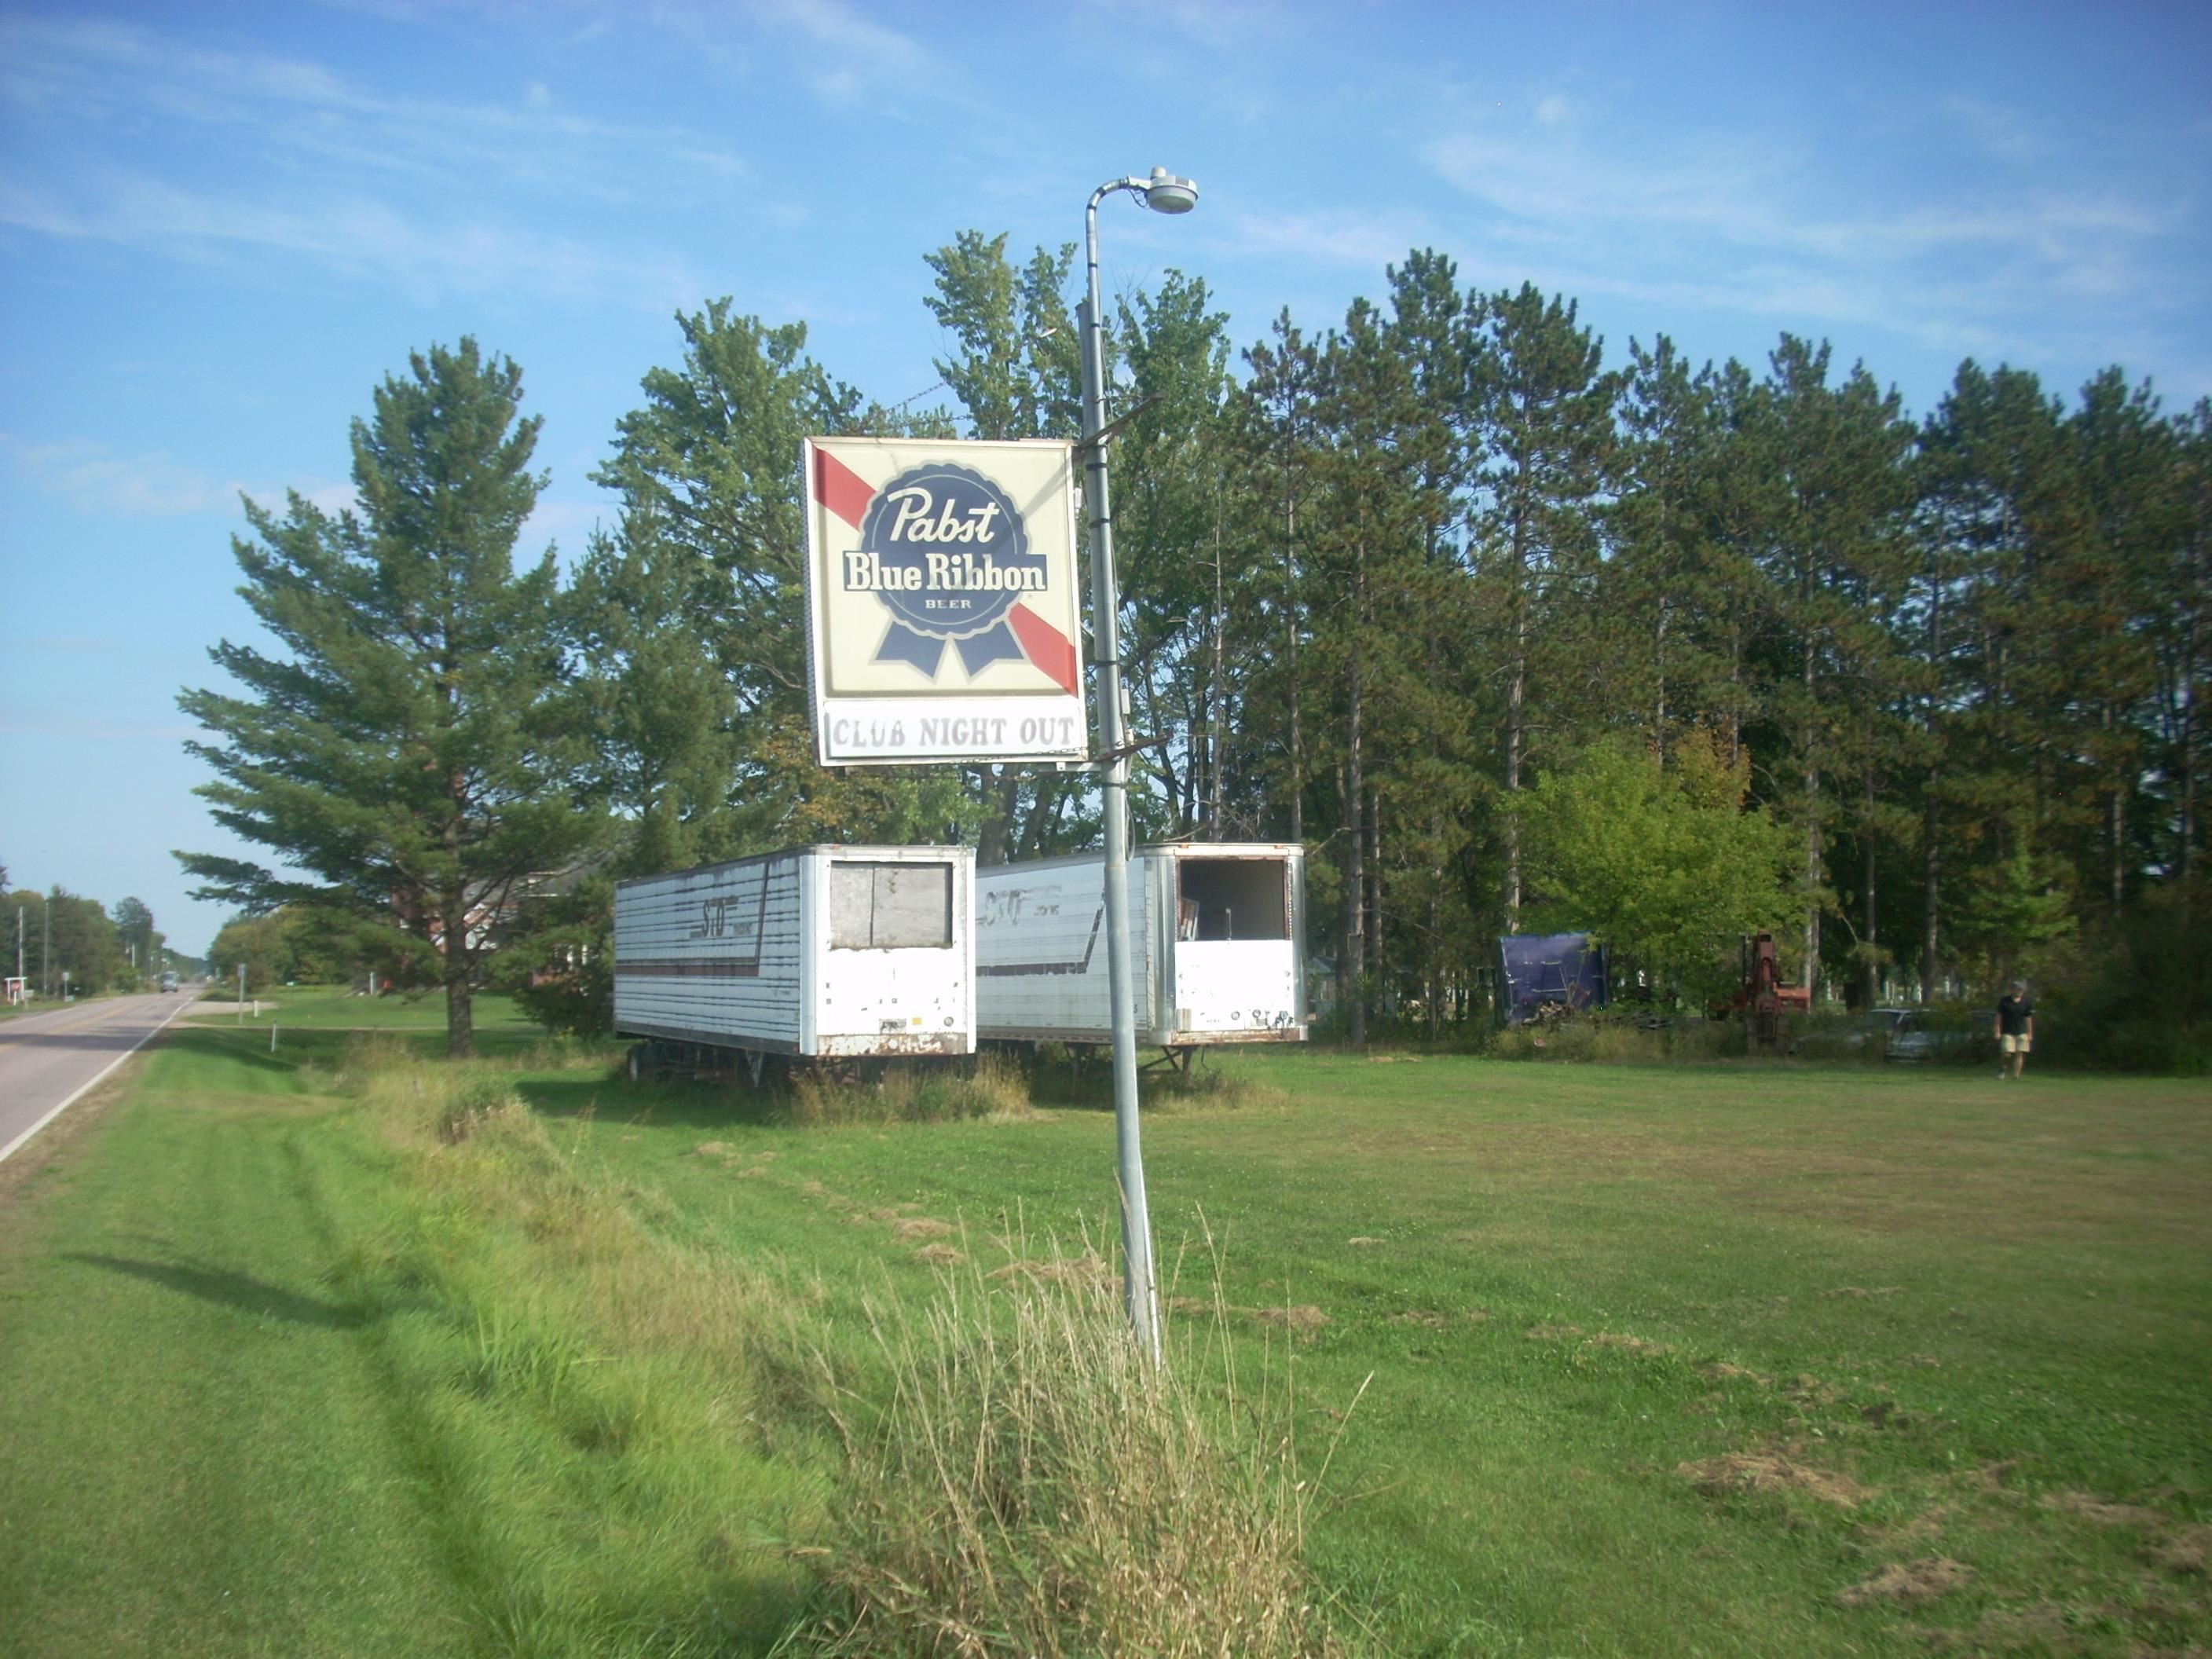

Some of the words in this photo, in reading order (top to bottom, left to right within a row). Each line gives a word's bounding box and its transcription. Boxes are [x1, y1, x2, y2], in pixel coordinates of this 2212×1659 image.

[887, 487, 1000, 543] Pabst
[845, 552, 922, 591] Blue
[925, 553, 1046, 591] Ribbon
[925, 599, 972, 610] BEER
[833, 719, 906, 747] CLUB
[919, 717, 1006, 746] NIGHT
[1020, 717, 1074, 745] OUT
